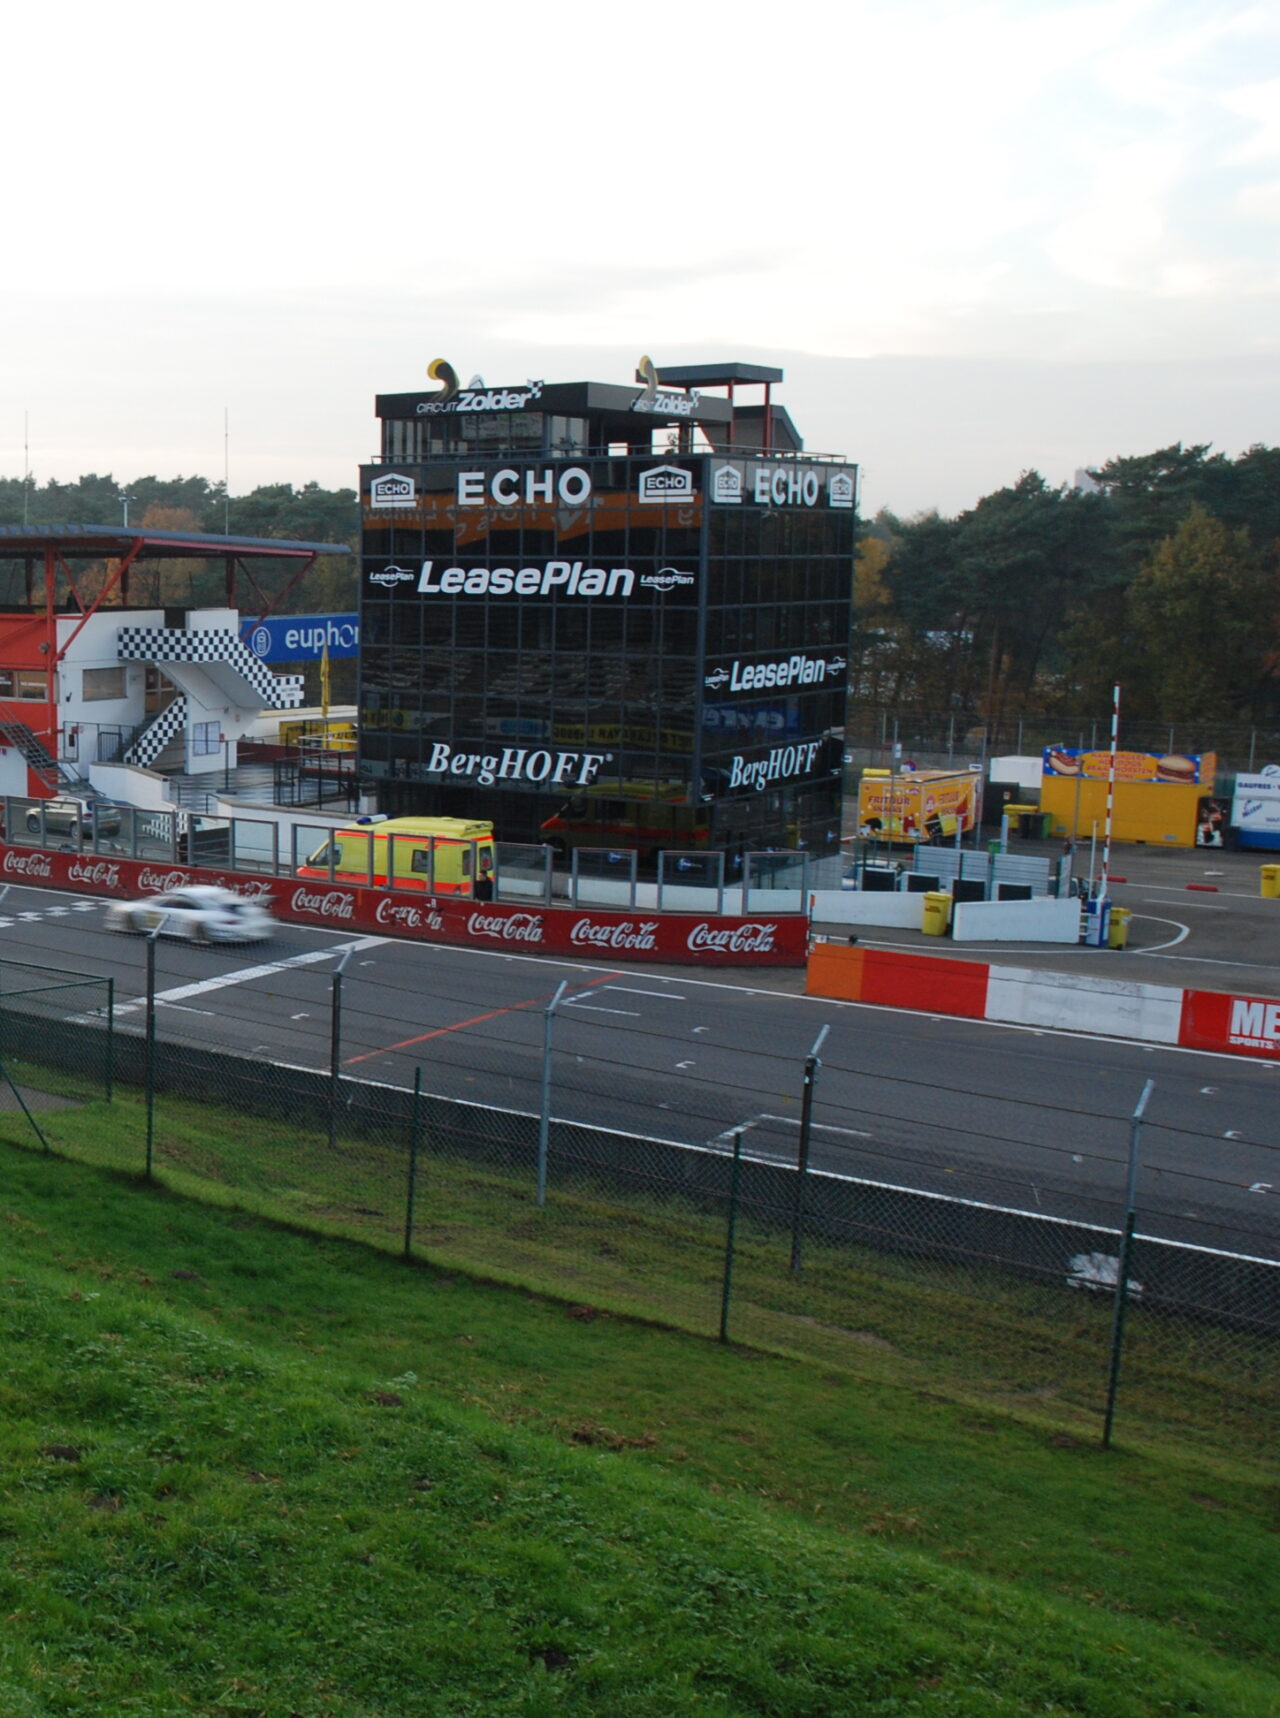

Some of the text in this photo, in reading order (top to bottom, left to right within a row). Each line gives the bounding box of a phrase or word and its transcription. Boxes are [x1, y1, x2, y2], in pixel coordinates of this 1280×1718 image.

[456, 390, 529, 411] Zolder
[654, 394, 692, 415] Zolder
[377, 483, 410, 496] ECHO
[458, 467, 592, 506] ECHO
[646, 476, 686, 489] ECHO
[755, 468, 818, 506] ECHO
[370, 570, 414, 582] LeasePlan
[417, 561, 635, 597] LeasePlan
[640, 574, 694, 585] LeasePlan
[730, 655, 826, 691] LeasePlan
[427, 742, 604, 786] BergHOFF
[729, 742, 818, 791] BergHOFF
[4, 851, 51, 877] Coca-Cola
[292, 887, 355, 919] Coca-Cola
[468, 913, 545, 943] Coca-Cola
[571, 918, 659, 951] Coca-Cola
[687, 923, 777, 953] Coca-Cola
